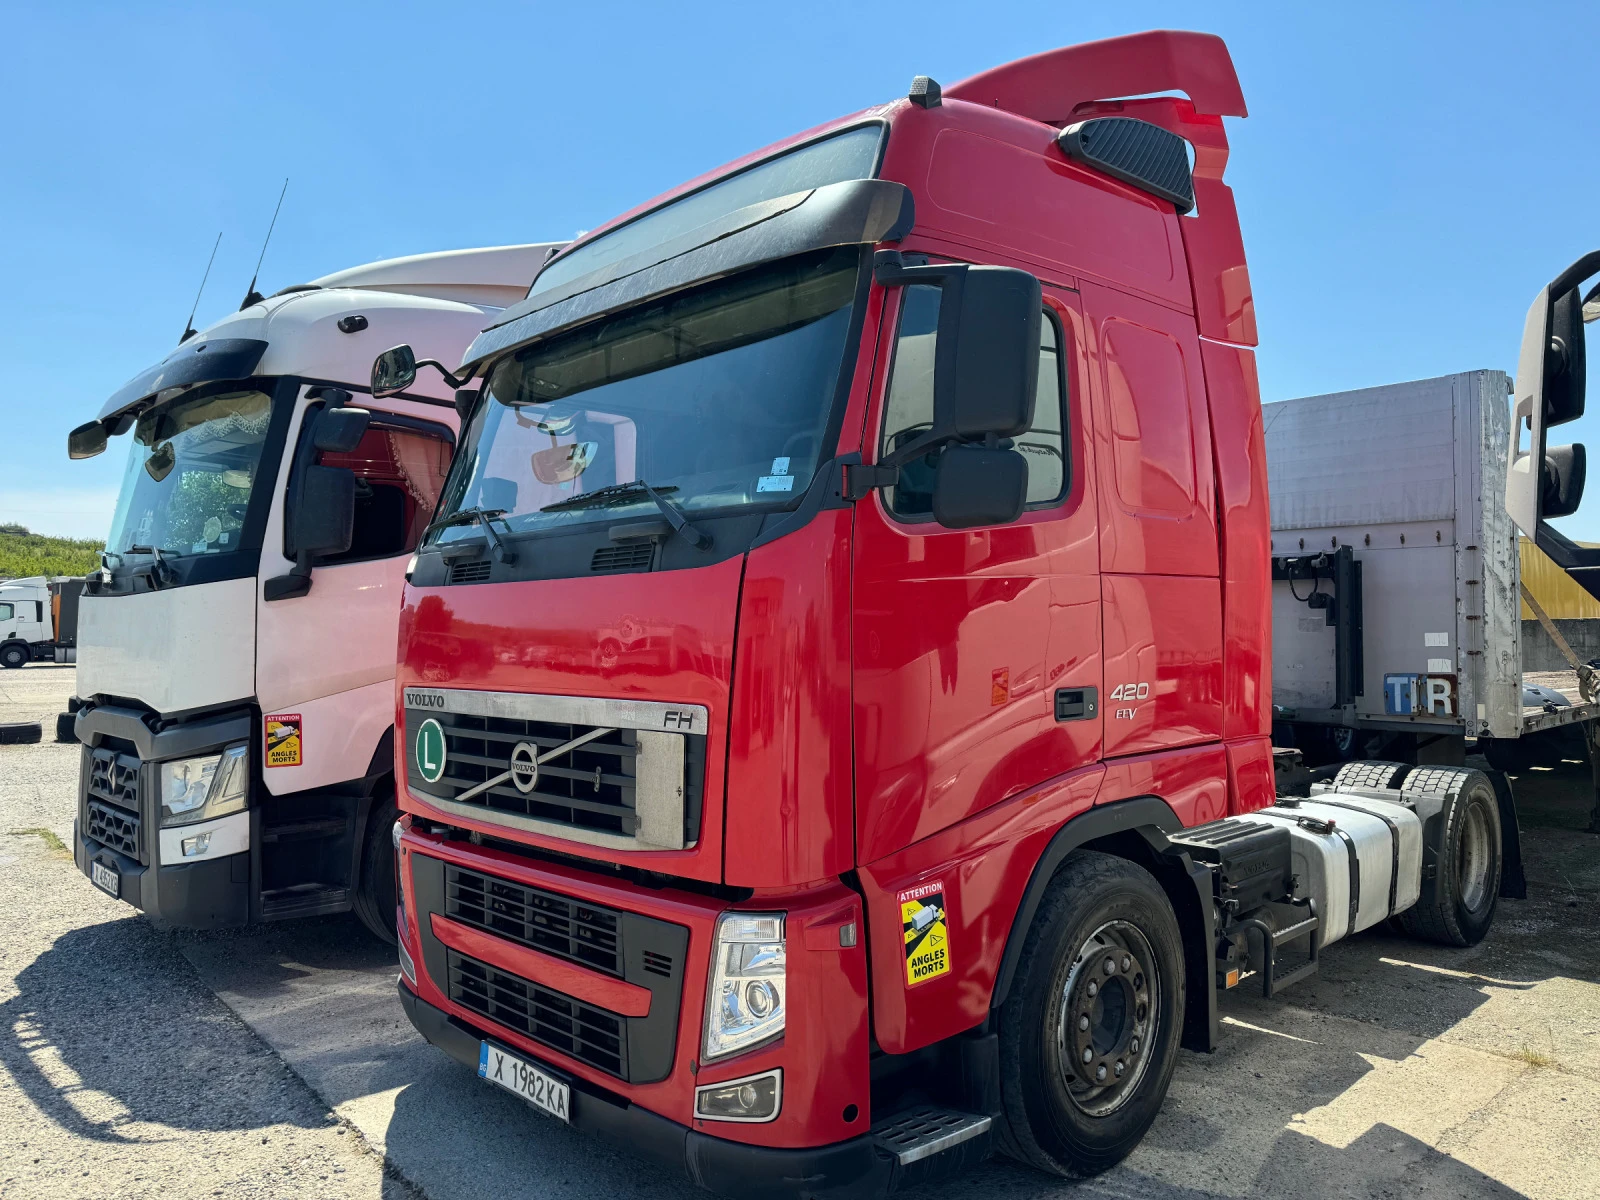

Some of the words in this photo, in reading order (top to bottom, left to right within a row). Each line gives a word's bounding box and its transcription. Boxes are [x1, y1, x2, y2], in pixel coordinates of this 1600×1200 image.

[406, 693, 445, 708] VOLVO
[1110, 682, 1149, 701] 420
[1386, 676, 1453, 714] TIR
[663, 710, 694, 729] FH
[1116, 707, 1138, 720] EEV
[271, 750, 297, 758] ANGLES
[424, 731, 436, 770] L
[511, 762, 536, 773] VOLVO
[900, 881, 943, 902] ATTENTION
[911, 948, 945, 968] ANGLES
[913, 959, 944, 979] MORTS
[479, 1062, 486, 1072] BG
[494, 1052, 504, 1081] X
[512, 1062, 566, 1117] 1982KA
